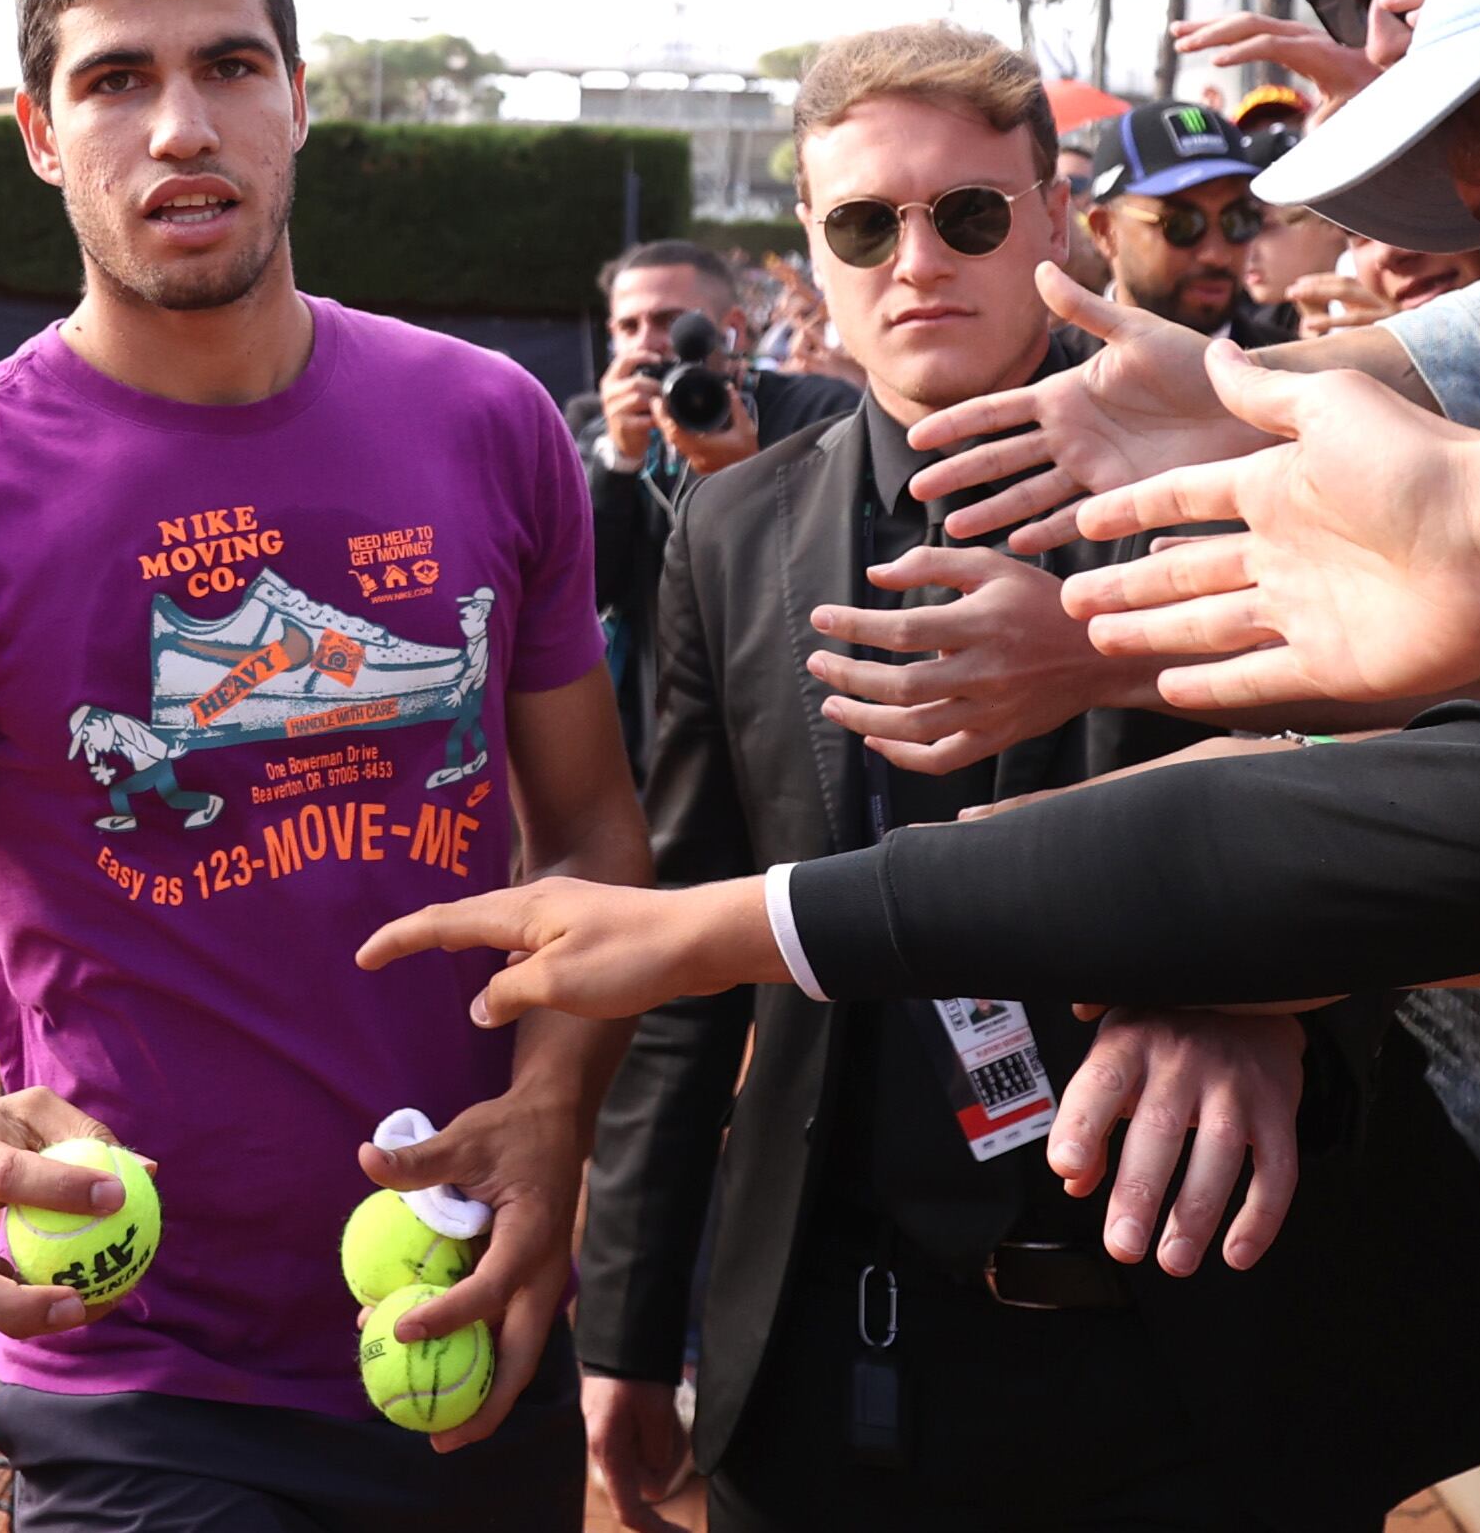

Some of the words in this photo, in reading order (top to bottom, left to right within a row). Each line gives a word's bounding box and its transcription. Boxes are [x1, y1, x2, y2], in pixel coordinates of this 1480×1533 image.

[157, 505, 258, 547] NIKE
[348, 534, 381, 552] NEED
[382, 528, 415, 547] HELP
[415, 525, 433, 540] TO
[137, 529, 285, 580] MOVING
[351, 549, 374, 566] GET
[376, 540, 433, 562] MOVING?
[187, 566, 246, 598] CO.
[370, 586, 434, 604] WWW.NIKE.COM
[196, 648, 274, 719] HEAVY
[290, 715, 336, 736] HANDLE
[336, 707, 365, 727] WITH
[364, 700, 397, 721] CARE
[265, 762, 287, 781] One
[287, 750, 344, 775] Bowerman
[347, 744, 379, 761] Drive
[96, 846, 145, 901] Easy
[151, 875, 183, 907] as
[192, 802, 480, 899] 123-MOVE-ME
[51, 1222, 139, 1290] ATP
